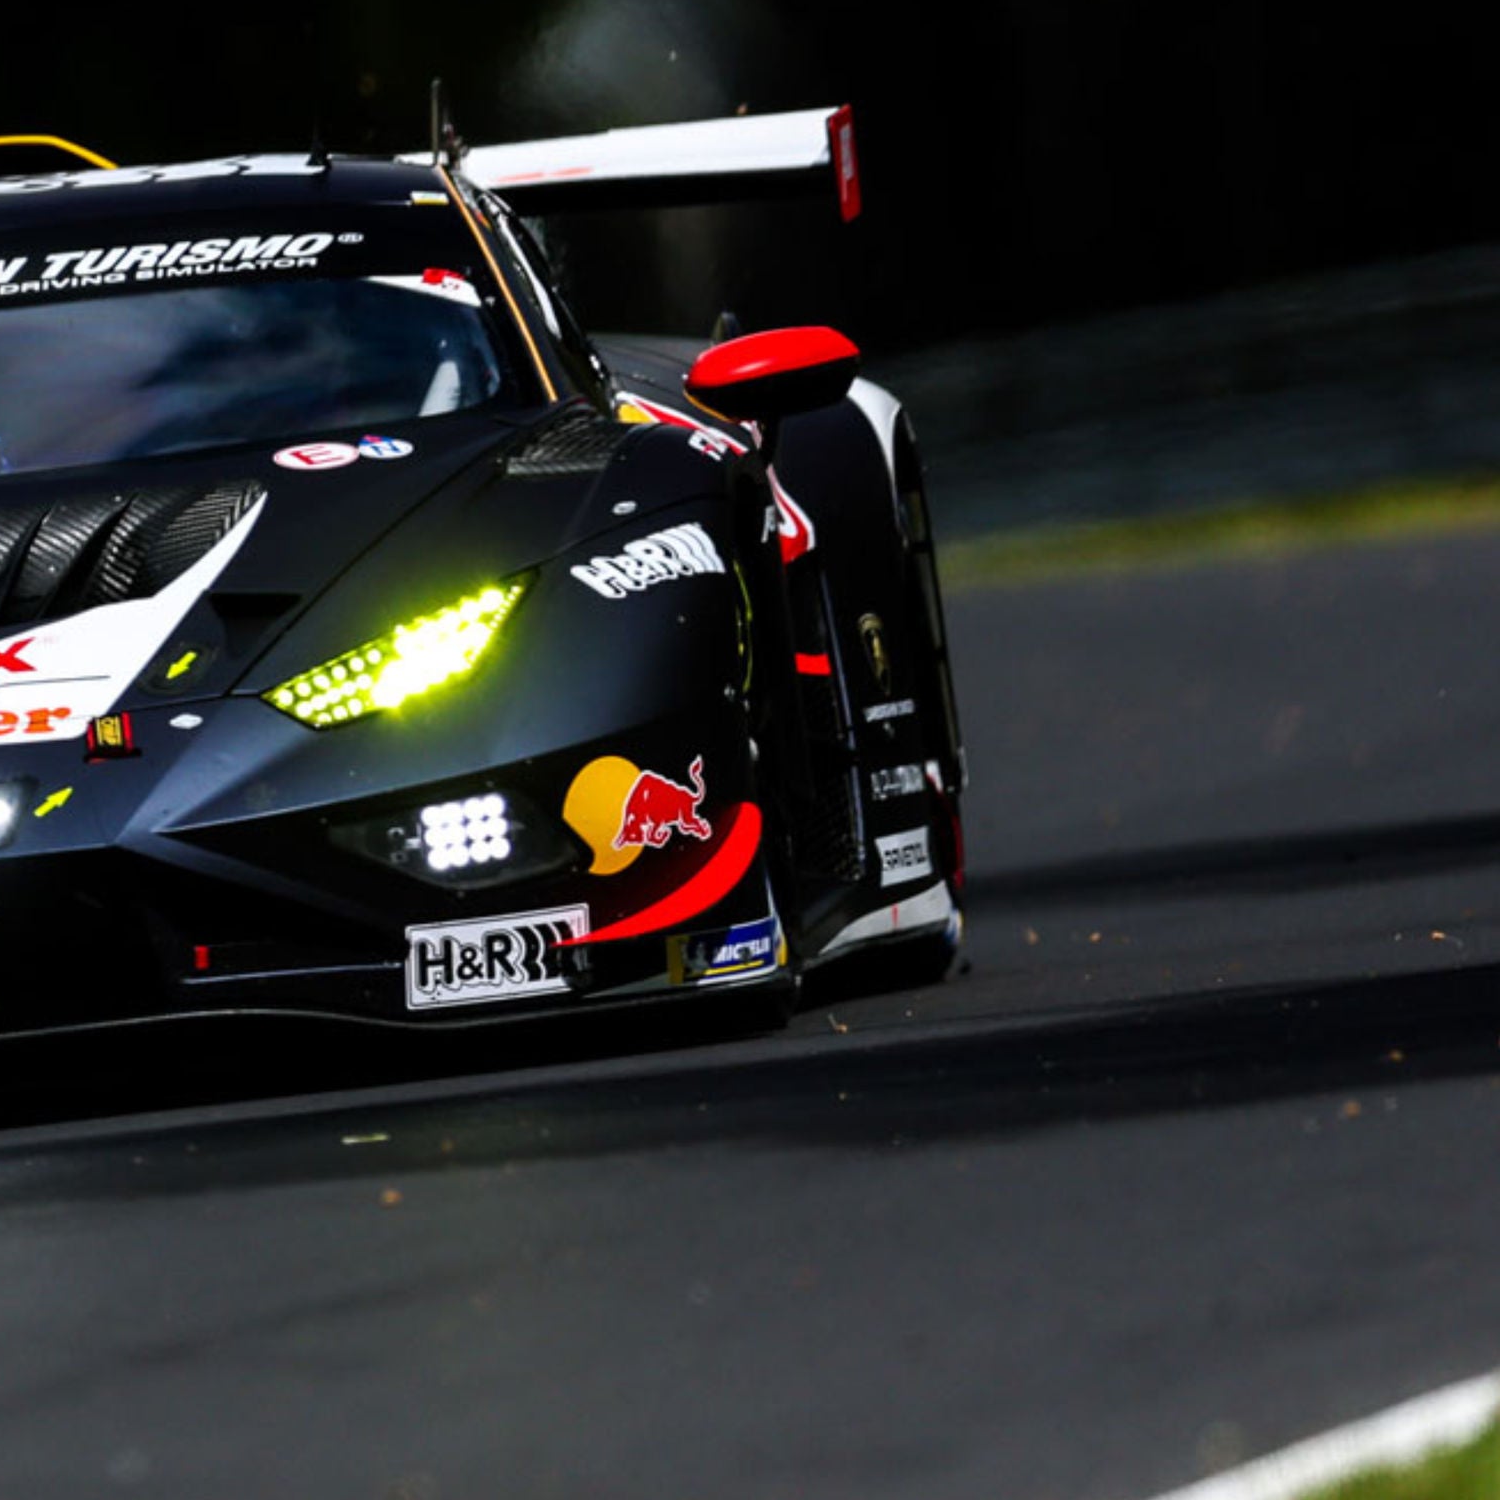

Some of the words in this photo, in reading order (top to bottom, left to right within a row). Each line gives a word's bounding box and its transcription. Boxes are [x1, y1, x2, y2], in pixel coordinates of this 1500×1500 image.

[0, 272, 126, 296] DRIVING
[135, 256, 319, 282] SIMULATOR
[40, 233, 334, 280] TURISMO
